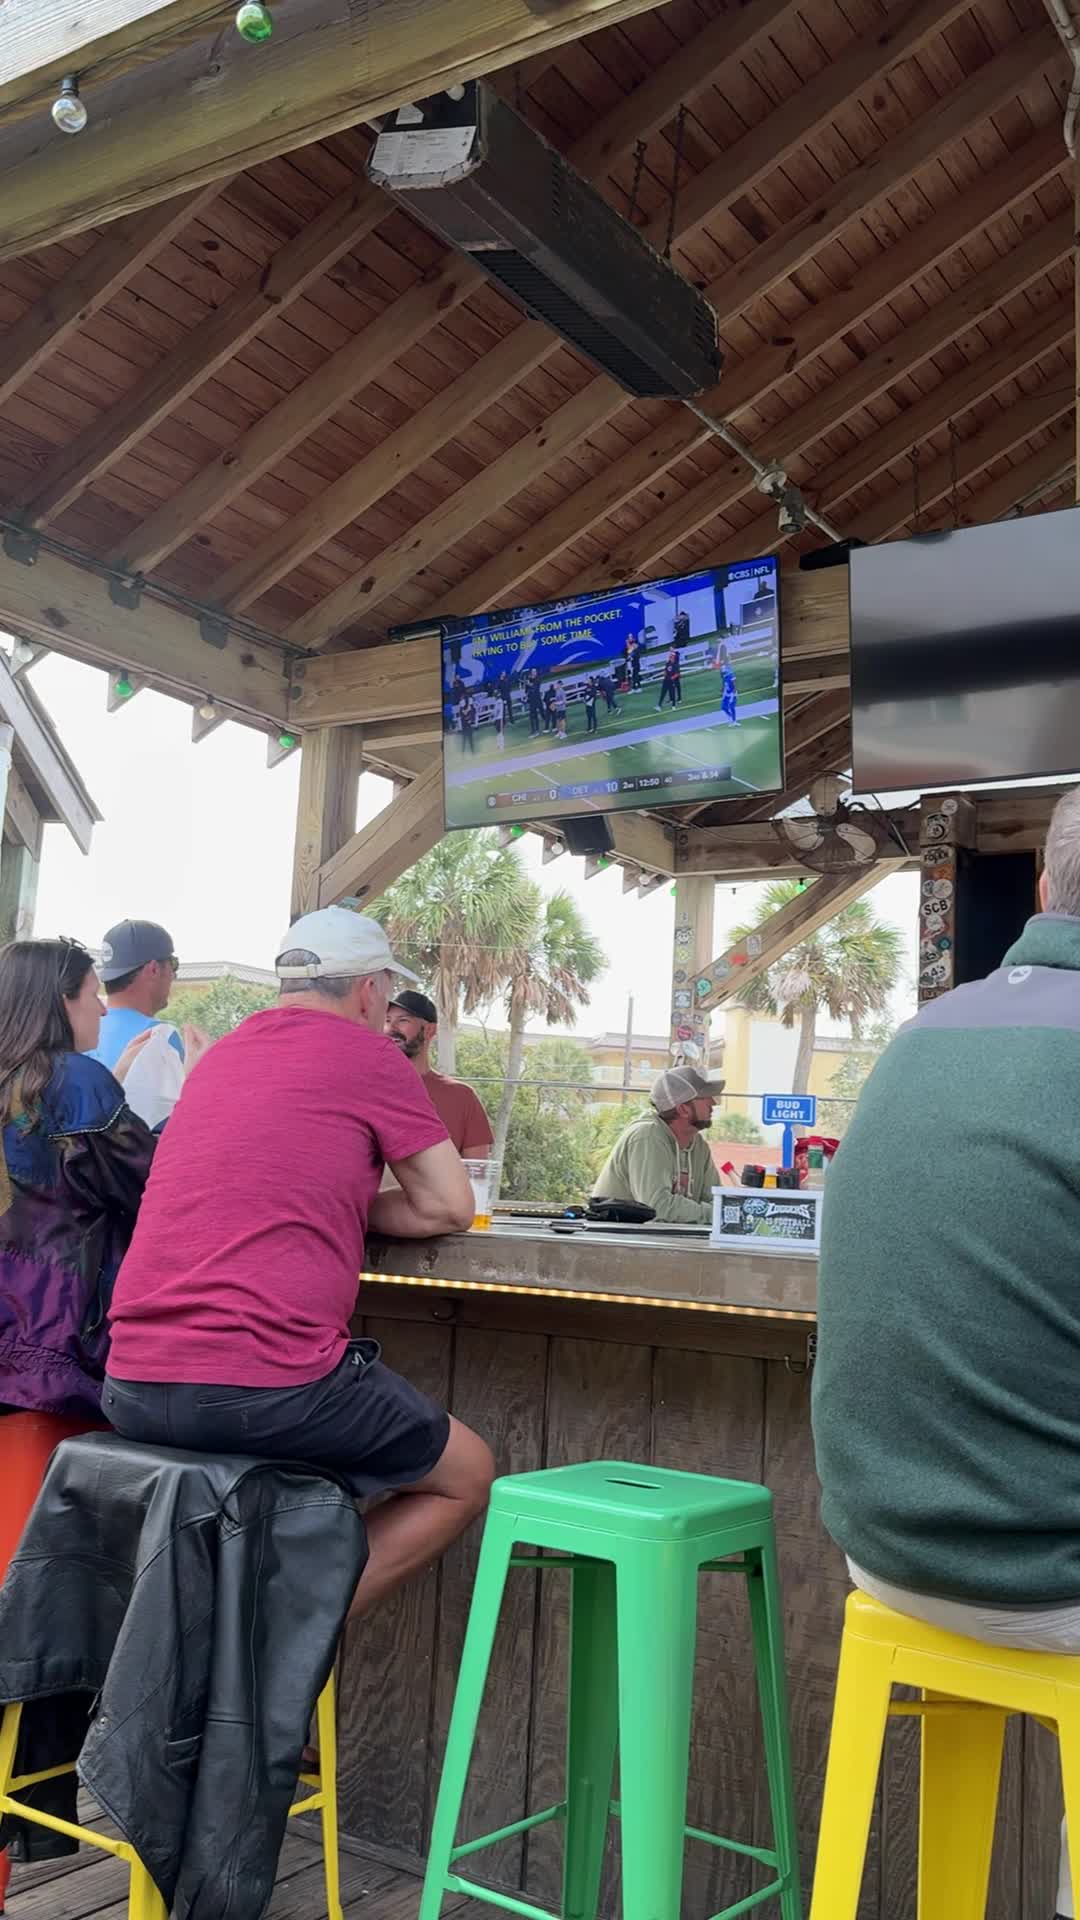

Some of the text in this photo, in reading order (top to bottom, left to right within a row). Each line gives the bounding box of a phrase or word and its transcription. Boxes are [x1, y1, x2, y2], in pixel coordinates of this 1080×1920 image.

[754, 566, 770, 576] NFL
[535, 622, 562, 633] FROM
[565, 617, 582, 627] THE
[584, 609, 623, 624] POCKET.
[472, 645, 503, 657] TRYING
[506, 642, 518, 652] TO
[541, 634, 567, 646] SOME
[606, 781, 618, 792] 10
[639, 778, 660, 787] 12:50
[549, 789, 557, 800] 0
[924, 900, 948, 915] SCB
[776, 1100, 800, 1110] BUD
[772, 1110, 805, 1119] LIGHT
